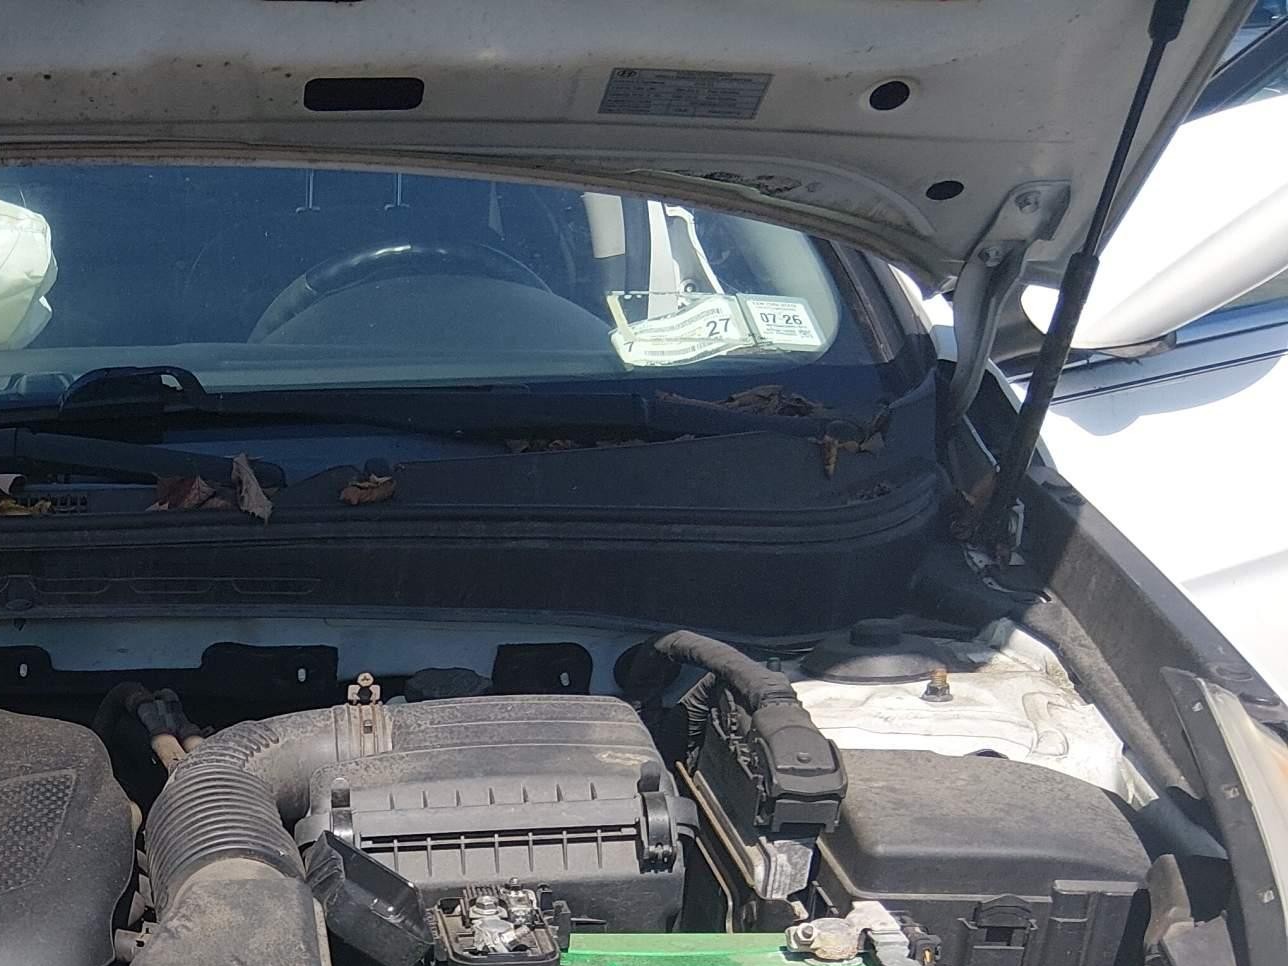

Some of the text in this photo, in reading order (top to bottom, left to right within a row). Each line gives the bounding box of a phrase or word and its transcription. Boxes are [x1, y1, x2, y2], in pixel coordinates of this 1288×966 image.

[759, 312, 803, 325] 07 26
[706, 318, 730, 337] 27
